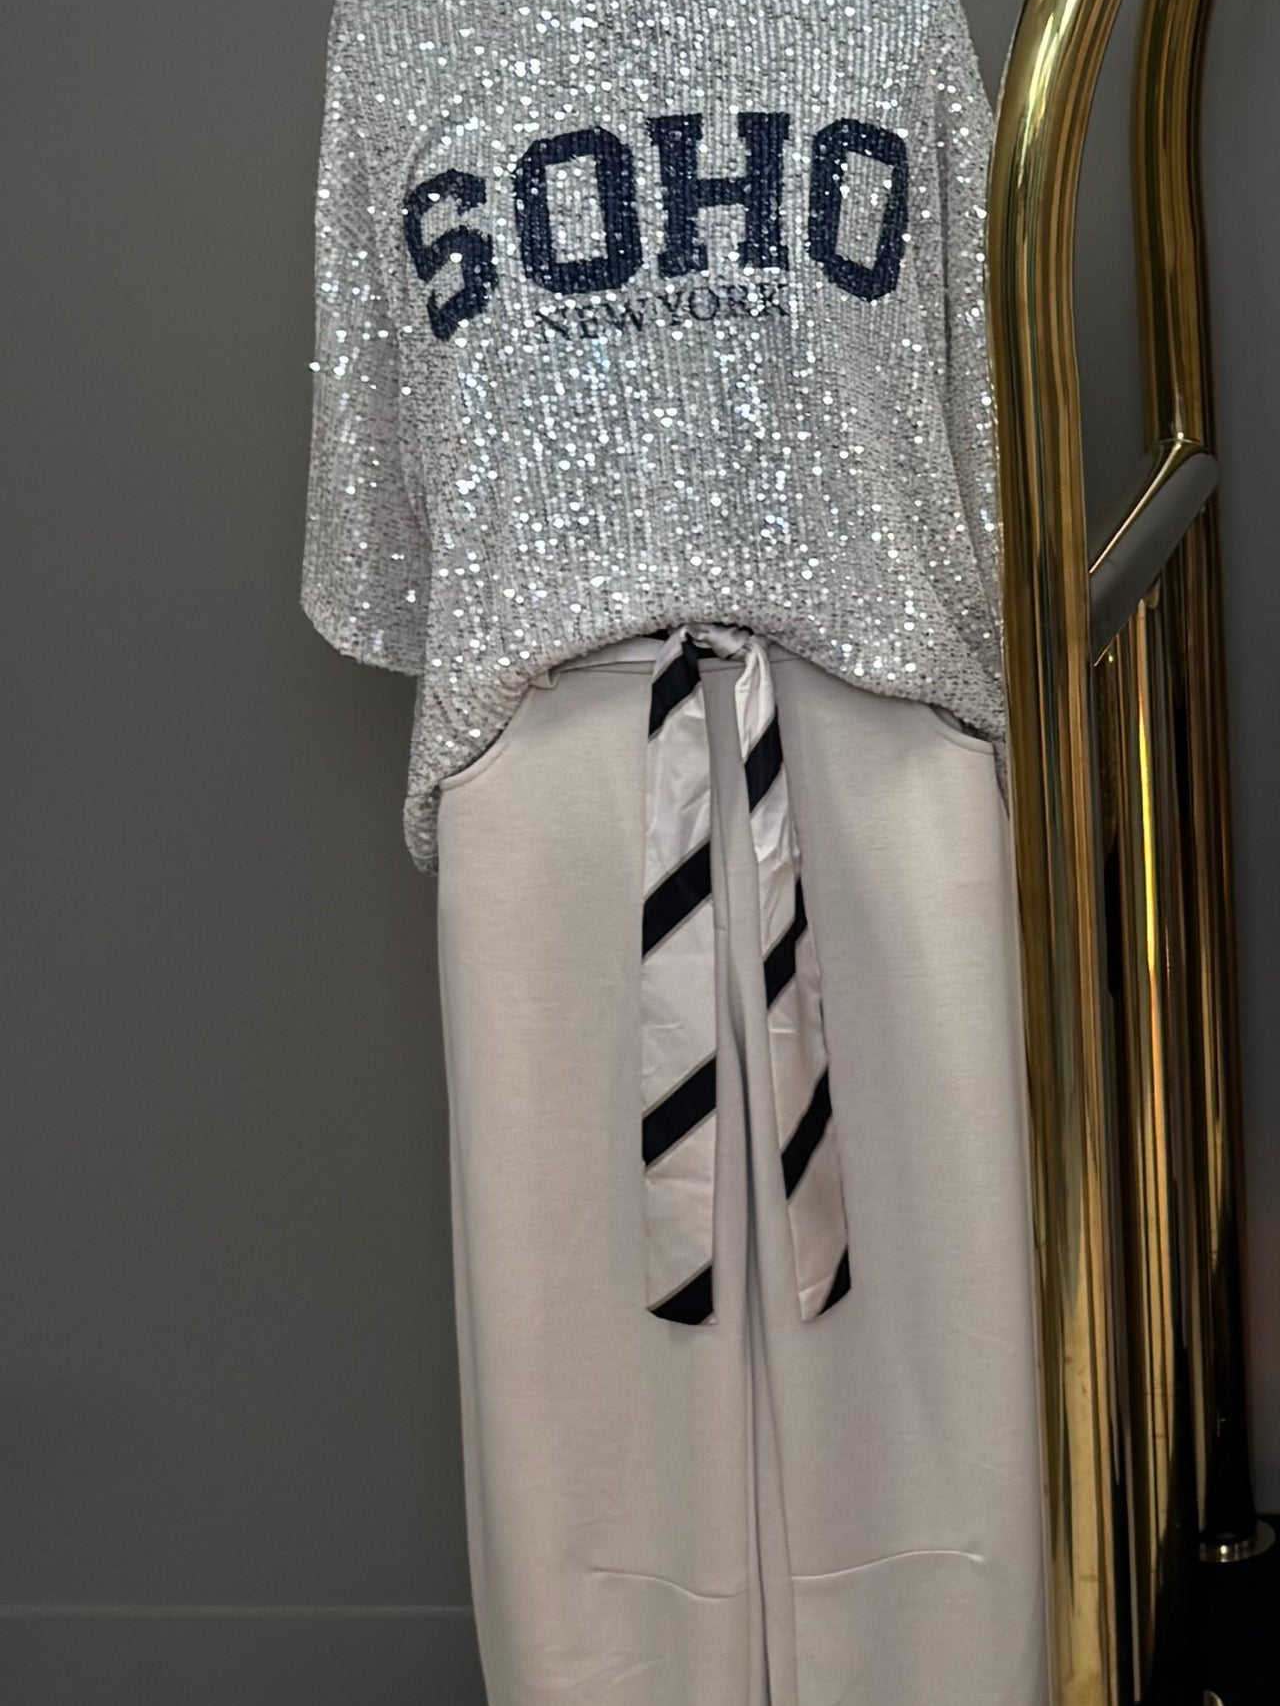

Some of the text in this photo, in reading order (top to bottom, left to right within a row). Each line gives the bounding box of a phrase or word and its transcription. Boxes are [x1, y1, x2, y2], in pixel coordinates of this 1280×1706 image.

[402, 111, 909, 342] SOHO
[534, 283, 791, 343] NEW YORK
